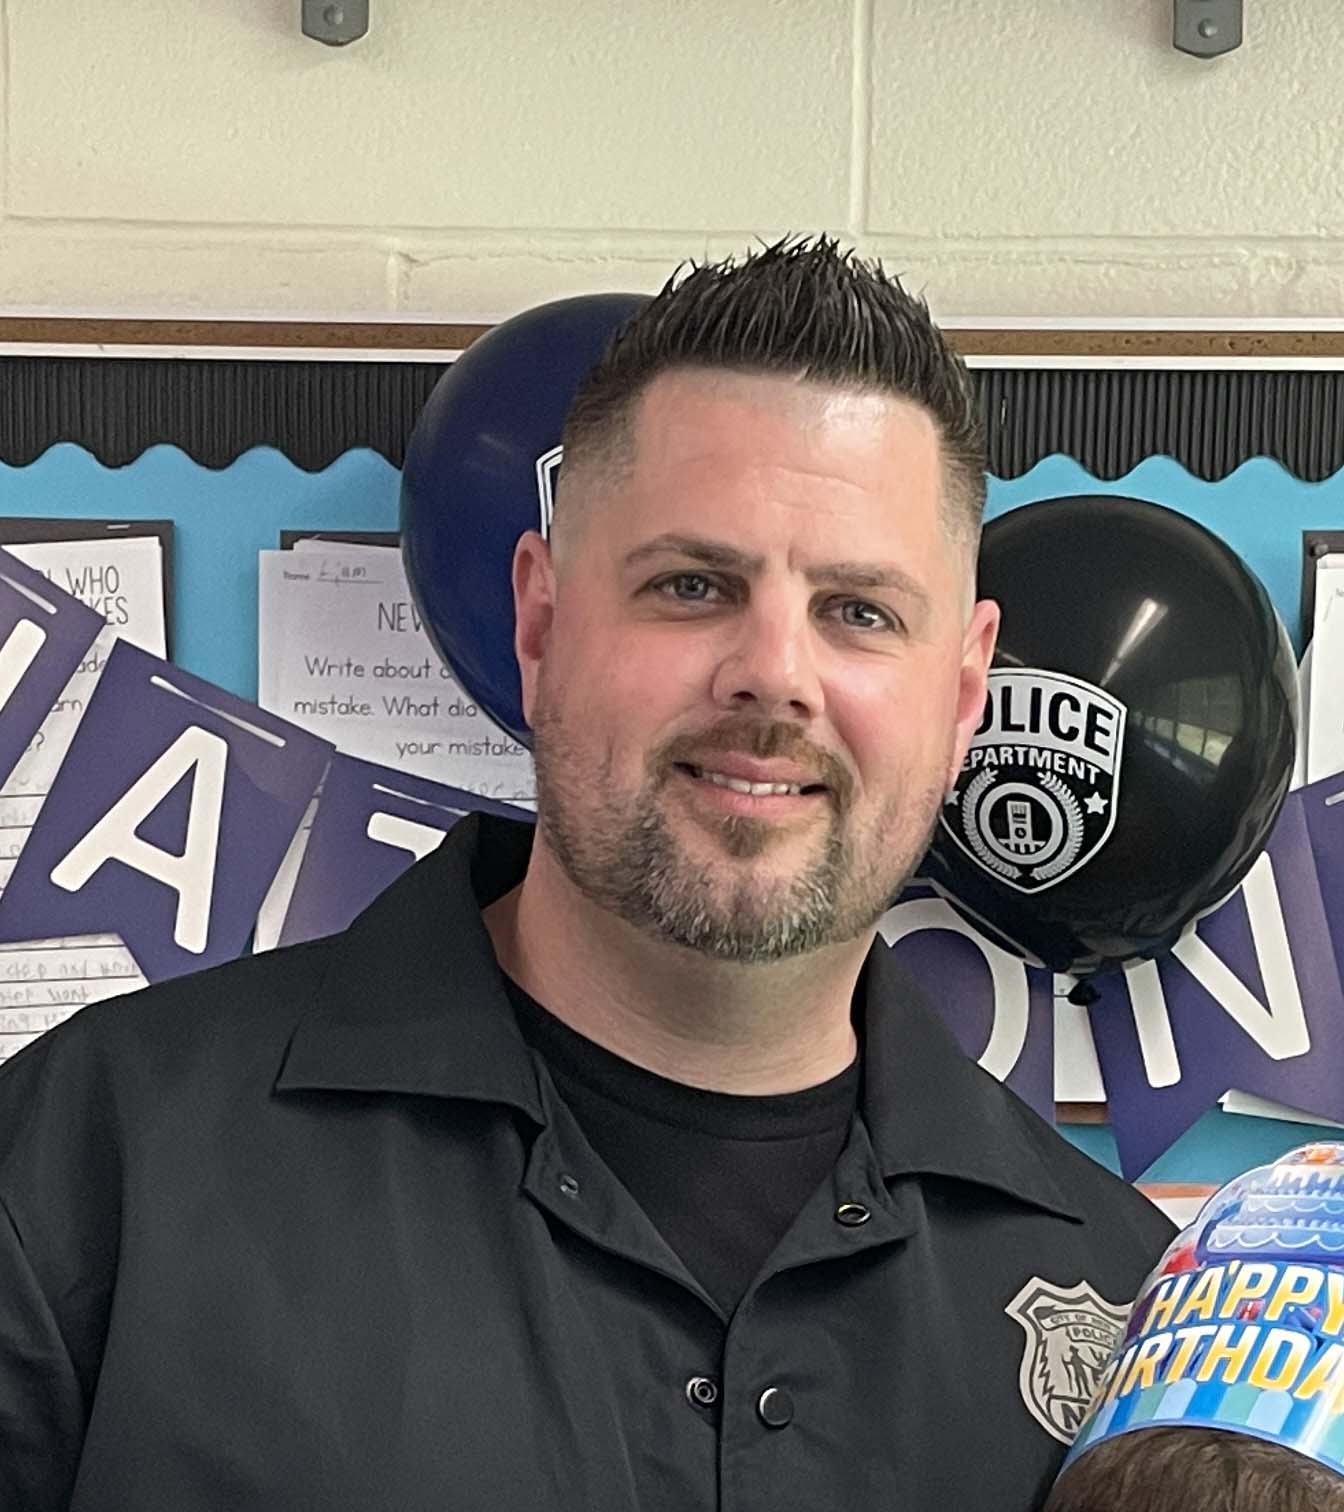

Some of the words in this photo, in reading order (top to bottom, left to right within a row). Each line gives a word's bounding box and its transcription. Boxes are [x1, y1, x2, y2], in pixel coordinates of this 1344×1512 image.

[66, 565, 120, 595] WHO
[305, 655, 365, 678] Write
[373, 657, 431, 679] about
[294, 694, 375, 717] mistake.
[382, 696, 439, 717] What
[396, 741, 441, 759] your
[959, 746, 1101, 785] EPARTMENT
